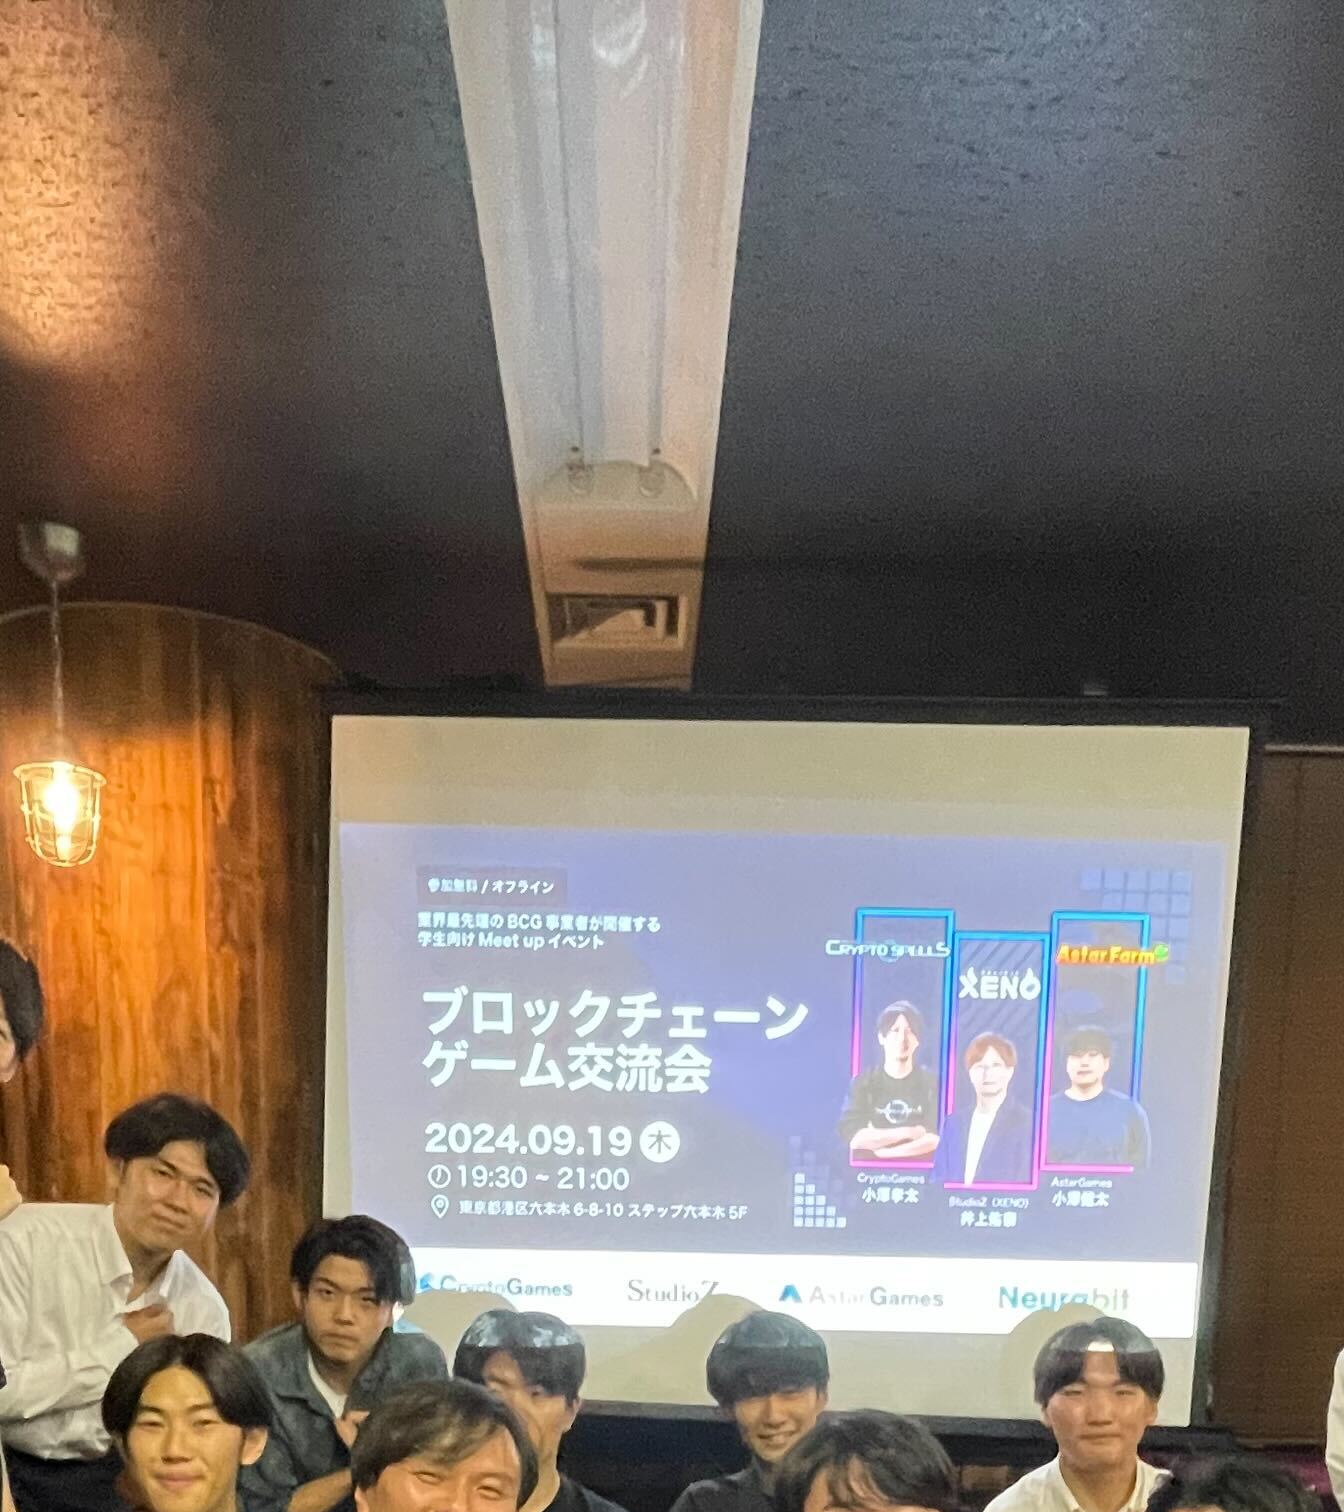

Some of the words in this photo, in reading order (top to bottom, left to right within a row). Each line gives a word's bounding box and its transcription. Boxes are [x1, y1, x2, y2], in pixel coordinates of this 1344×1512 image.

[491, 880, 555, 895] オフライン
[507, 914, 542, 930] BCG
[417, 931, 474, 948] 学生向け
[479, 933, 520, 948] Meet
[523, 935, 545, 950] up
[548, 934, 604, 950] イベント
[958, 966, 1041, 1000] XENO
[422, 985, 808, 1040] ブロックチェーン
[422, 1039, 712, 1094] ゲーム交流会
[424, 1122, 632, 1157] 2024.09.19
[457, 1164, 527, 1189] 19:30
[557, 1167, 630, 1191] 21:00
[573, 1202, 624, 1218] 6-8-10
[628, 1203, 725, 1219] ステップ六本木
[728, 1205, 749, 1220] 5F
